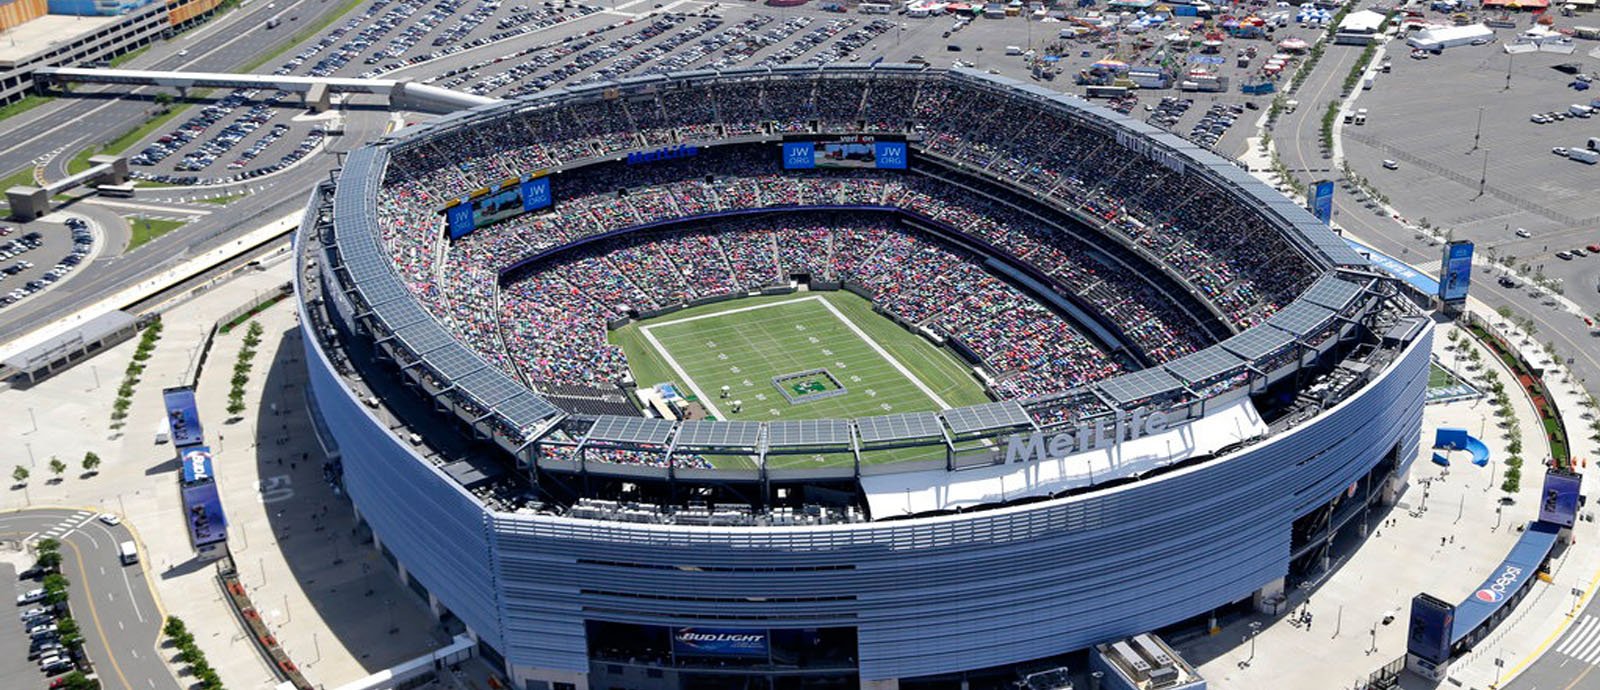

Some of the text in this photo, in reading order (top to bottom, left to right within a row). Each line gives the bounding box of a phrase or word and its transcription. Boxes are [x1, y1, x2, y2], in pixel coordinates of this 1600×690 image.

[790, 148, 809, 156] JW
[881, 147, 900, 156] JW
[528, 184, 546, 196] JW
[1004, 406, 1168, 465] MetLife
[1491, 565, 1522, 594] pepsi
[682, 633, 764, 642] BUD LIGHT
